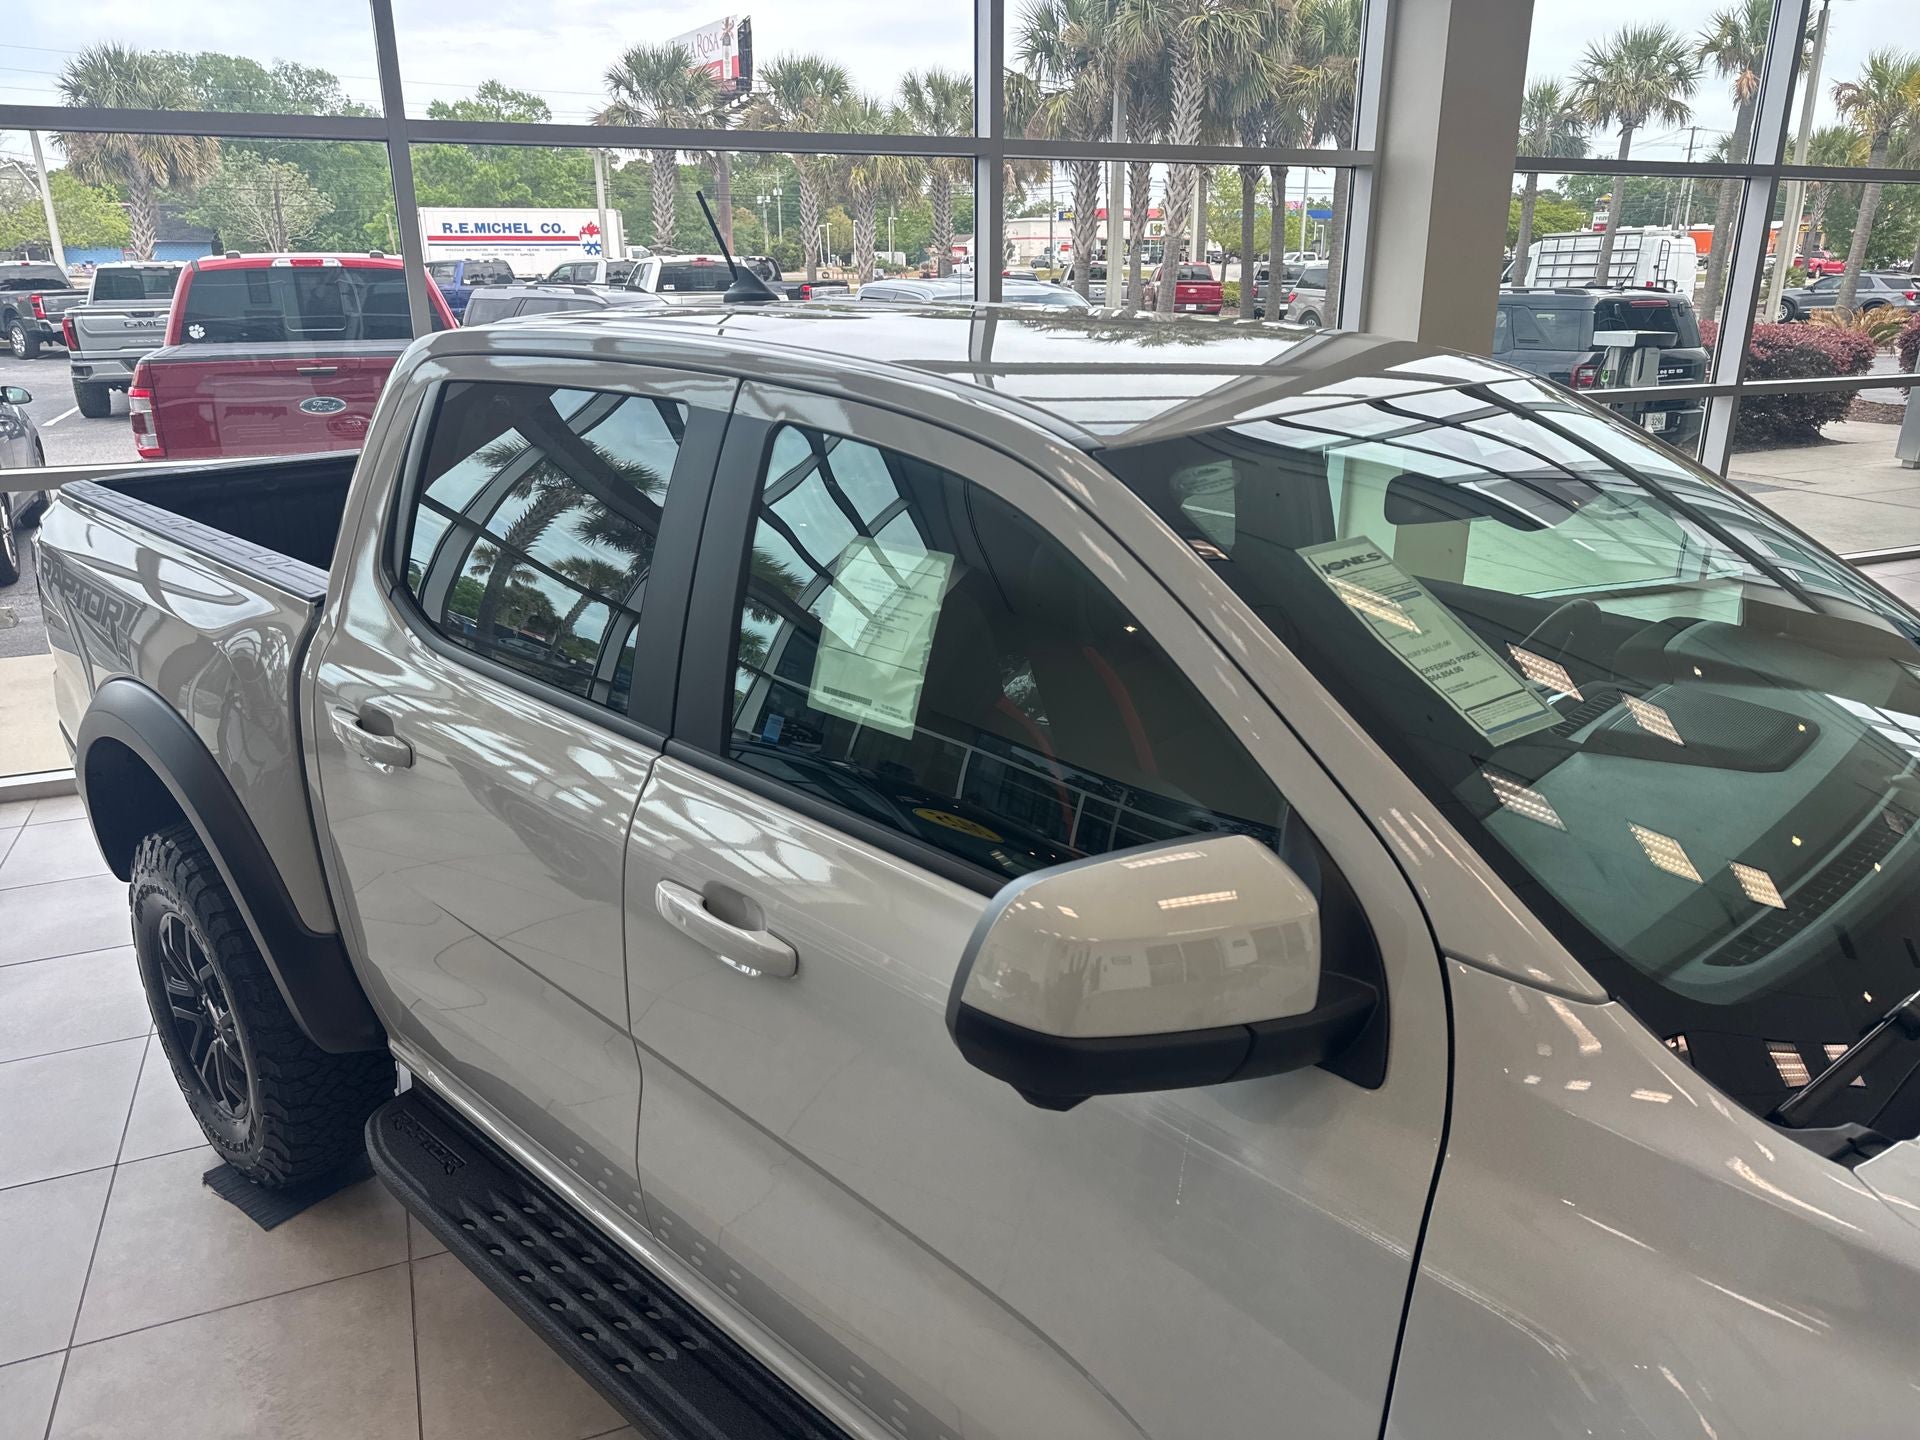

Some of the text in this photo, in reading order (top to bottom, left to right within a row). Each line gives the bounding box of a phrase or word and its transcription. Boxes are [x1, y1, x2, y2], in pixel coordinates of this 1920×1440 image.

[442, 222, 566, 234] R.E.MICHEL CO.
[124, 319, 166, 328] GMC
[310, 400, 336, 411] Ford
[1321, 552, 1382, 574] JONES
[40, 553, 125, 646] RAPTOR
[1420, 658, 1457, 674] OFFERING
